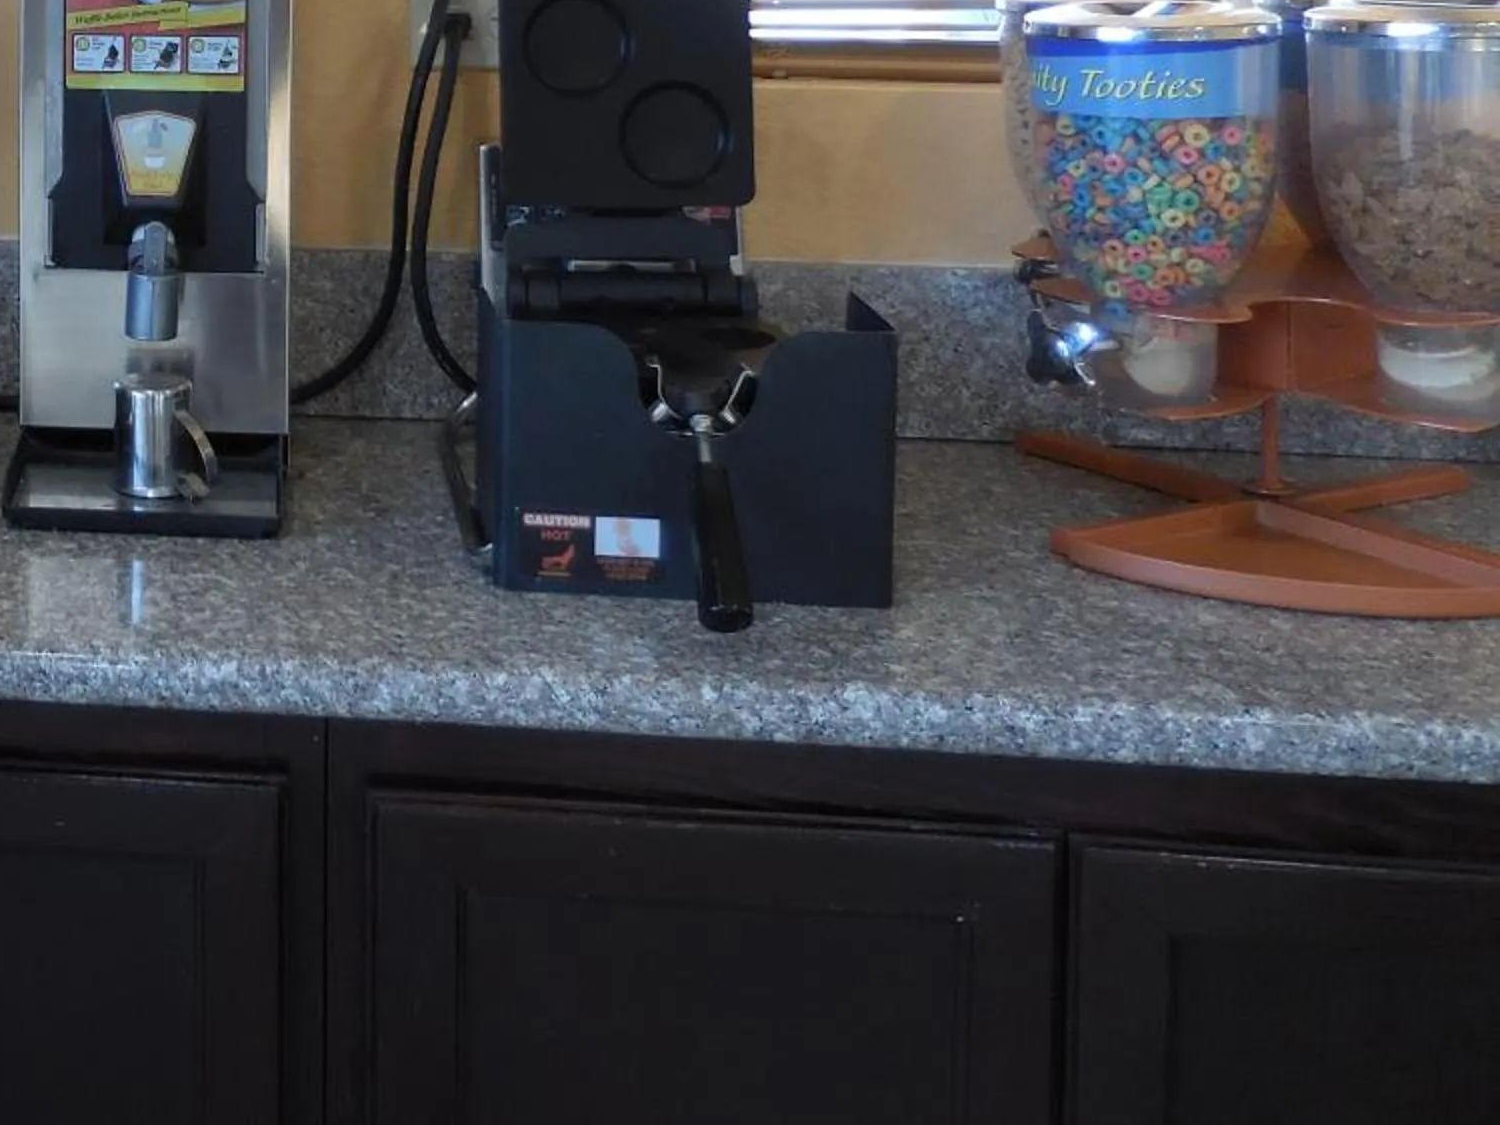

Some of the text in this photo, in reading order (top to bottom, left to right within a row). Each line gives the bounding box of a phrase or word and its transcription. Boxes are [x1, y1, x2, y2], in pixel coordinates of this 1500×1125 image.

[1079, 68, 1205, 102] Tooties
[523, 513, 591, 528] CAUTION
[540, 529, 571, 541] HOT
